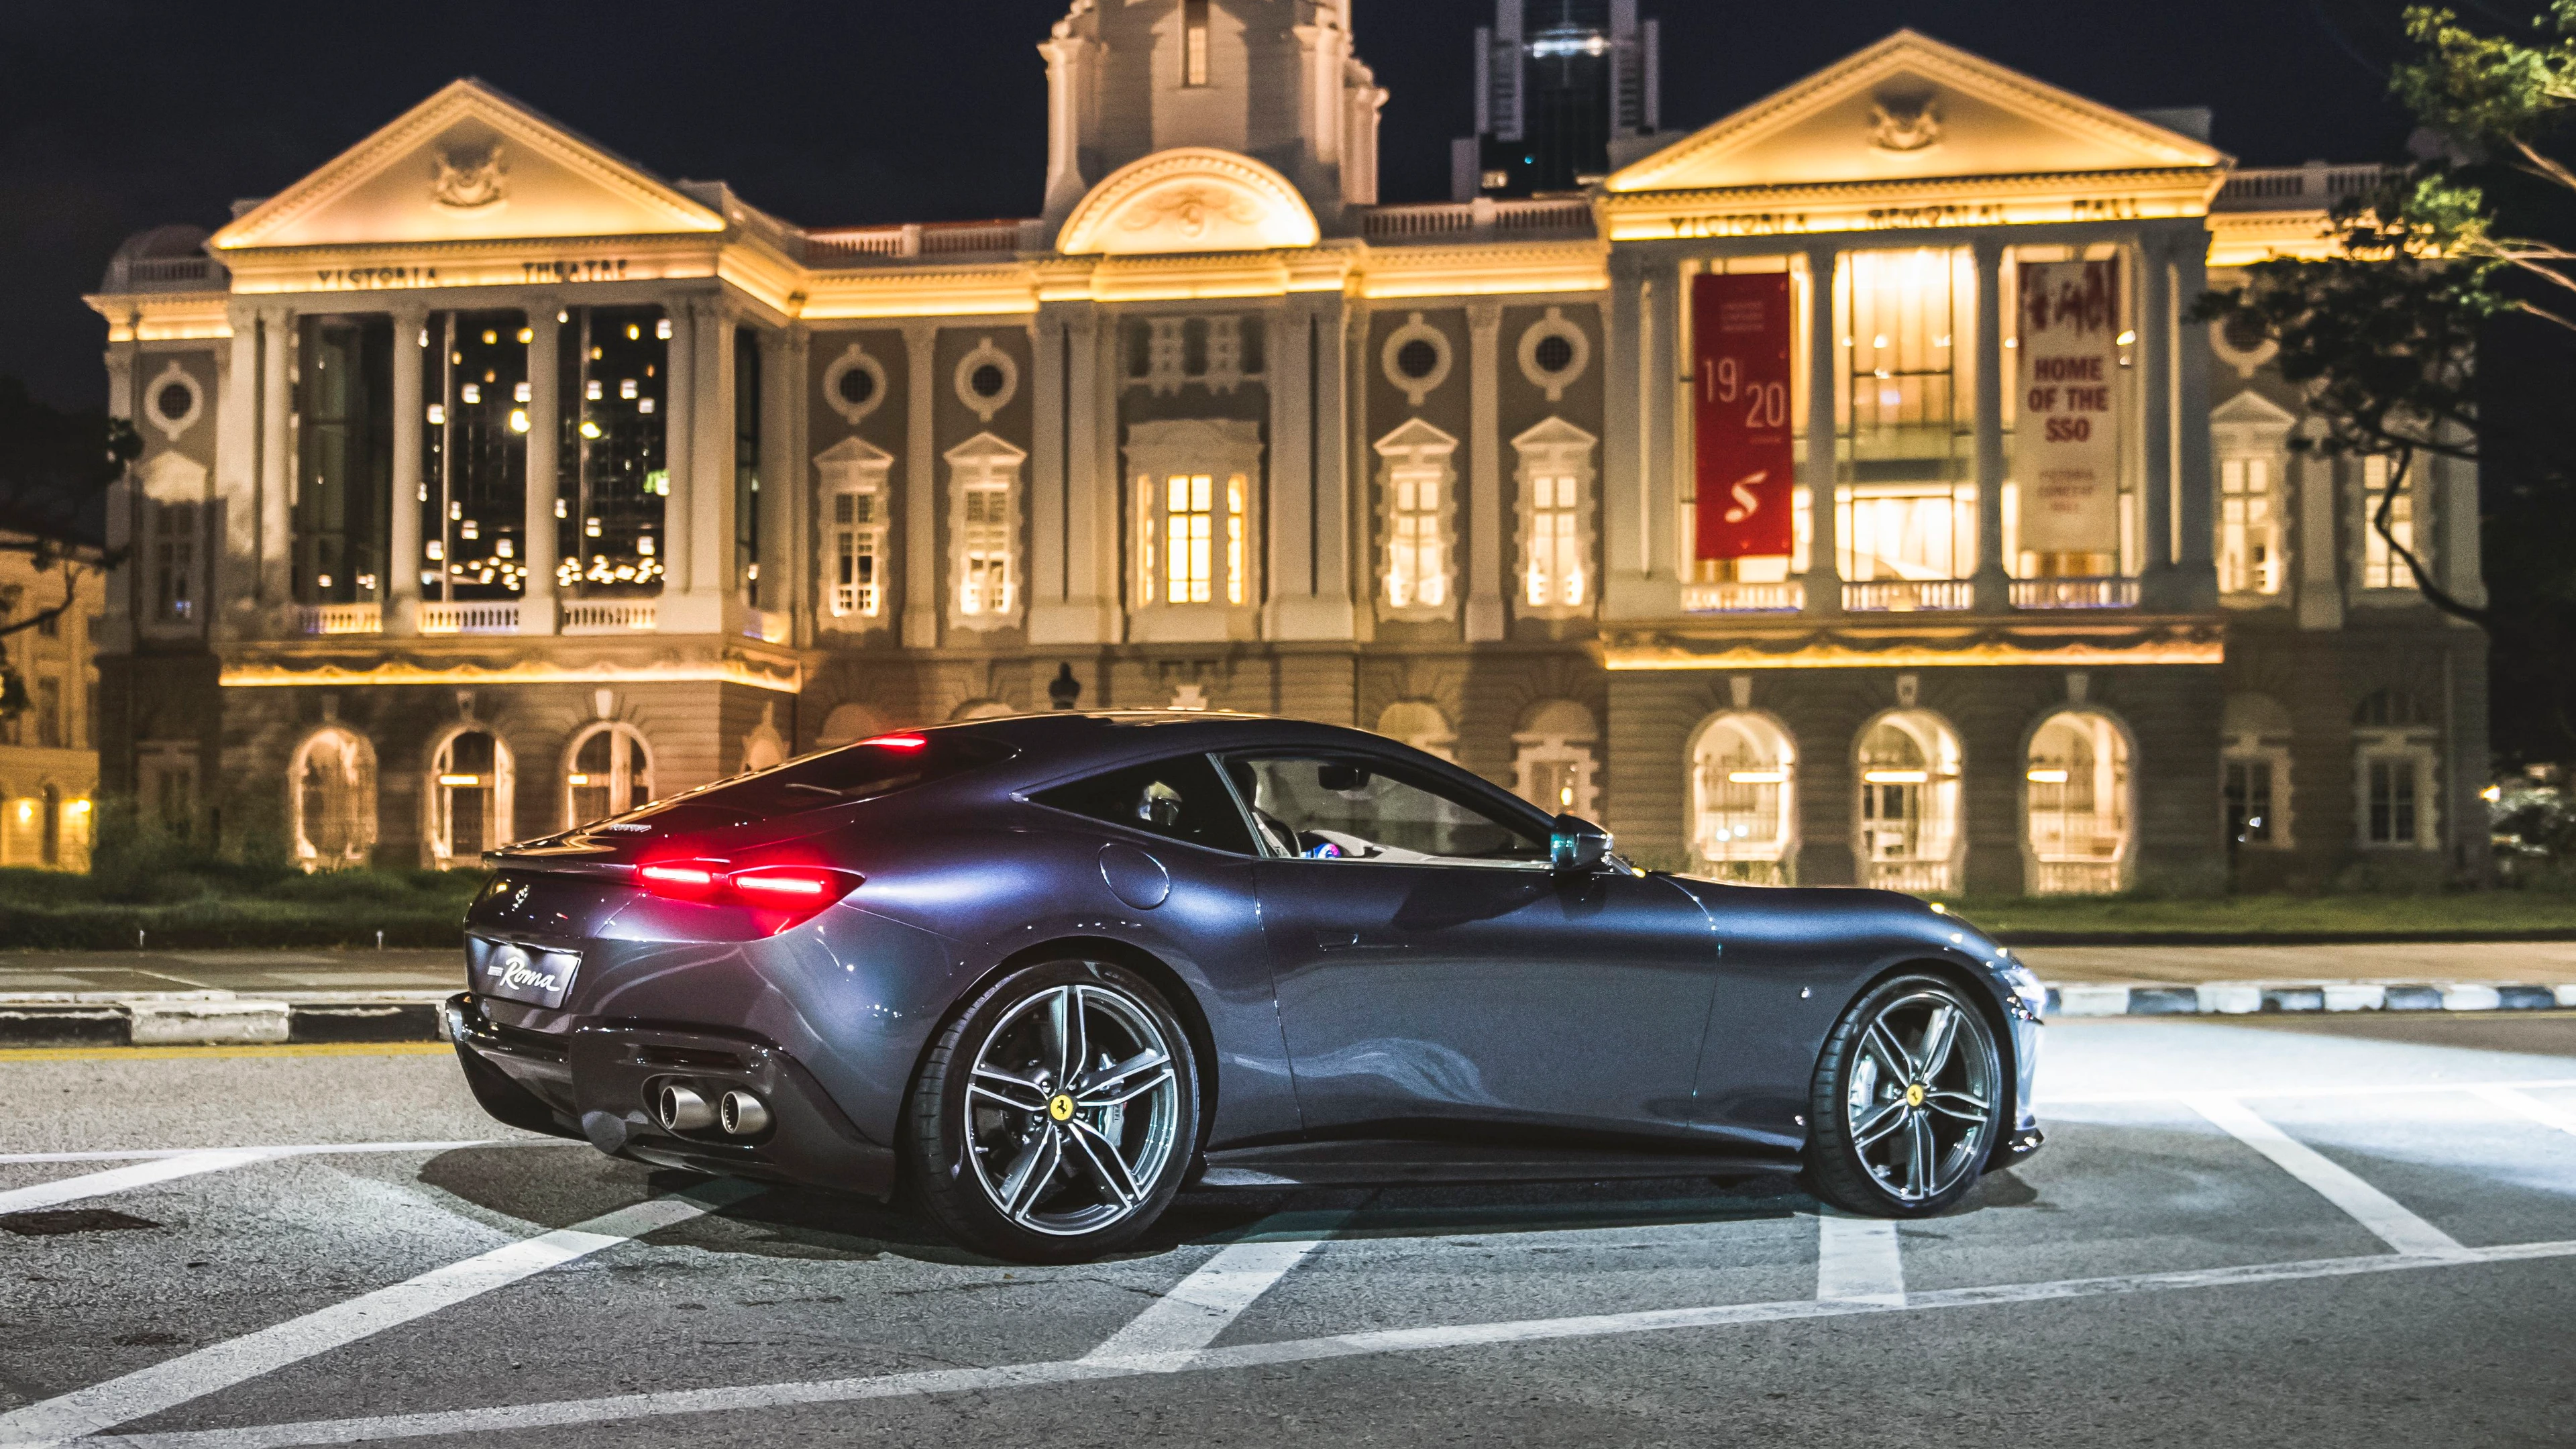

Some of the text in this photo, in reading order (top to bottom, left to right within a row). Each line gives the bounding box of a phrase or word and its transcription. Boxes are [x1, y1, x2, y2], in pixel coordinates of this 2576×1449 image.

[1703, 358, 1737, 402] 19
[2034, 356, 2104, 382] HOME
[1745, 381, 1785, 428] 20
[2028, 386, 2109, 412] OF THE
[2045, 417, 2090, 443] SSO
[499, 956, 561, 992] Roma
